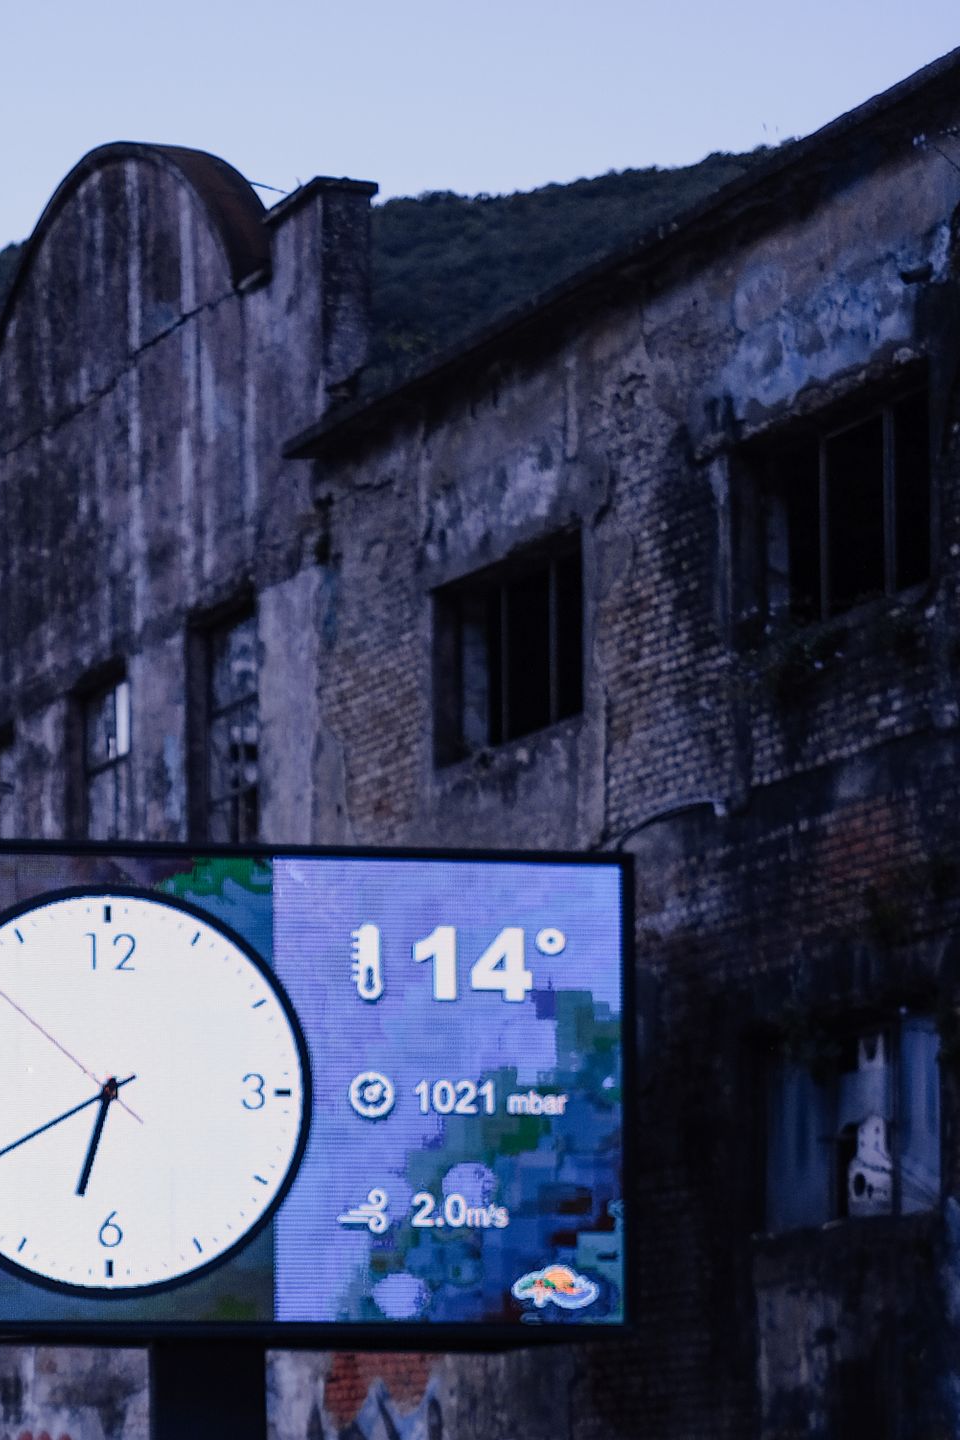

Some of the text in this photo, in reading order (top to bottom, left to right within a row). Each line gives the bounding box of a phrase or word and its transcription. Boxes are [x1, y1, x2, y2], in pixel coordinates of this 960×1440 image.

[85, 932, 136, 970] 12
[241, 1073, 265, 1109] 3
[415, 1079, 569, 1115] 1021 mbar
[99, 1211, 123, 1247] 6
